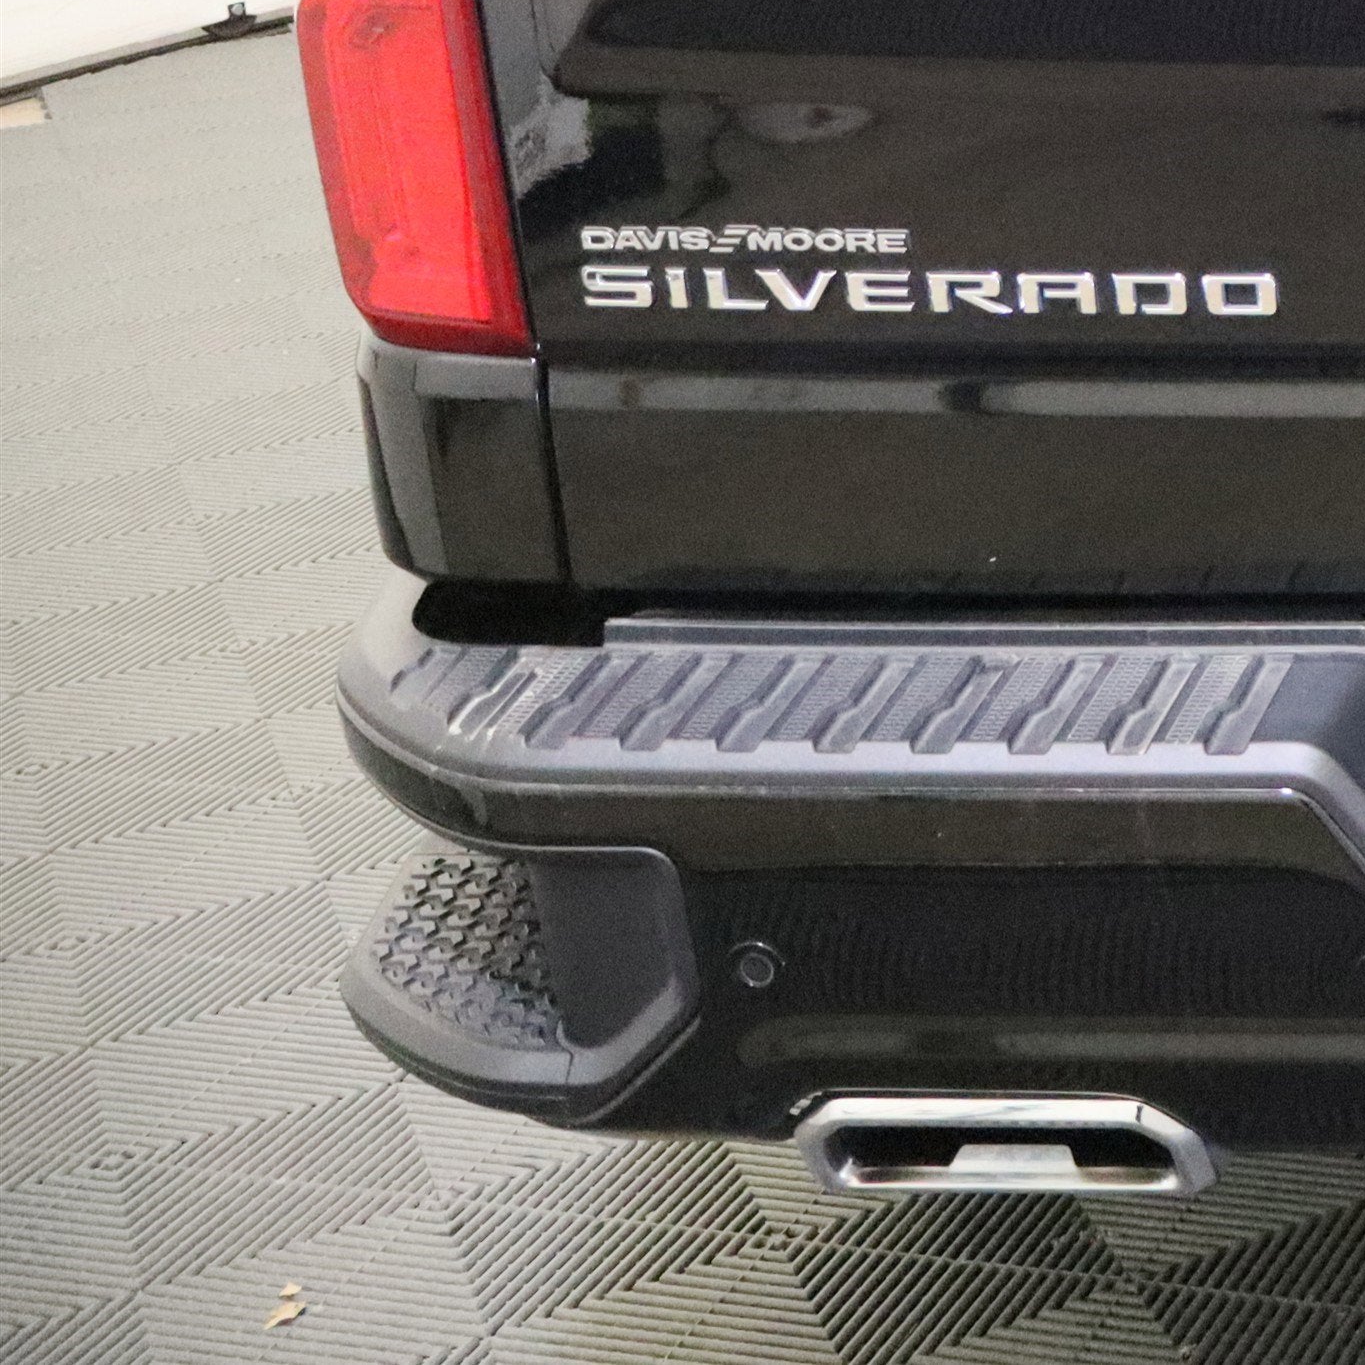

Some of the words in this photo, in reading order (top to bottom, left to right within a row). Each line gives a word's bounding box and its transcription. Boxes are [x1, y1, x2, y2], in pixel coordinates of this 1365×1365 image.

[580, 225, 712, 251] DAVIS
[746, 227, 909, 254] MOORE
[581, 264, 1279, 317] SILVERADO
